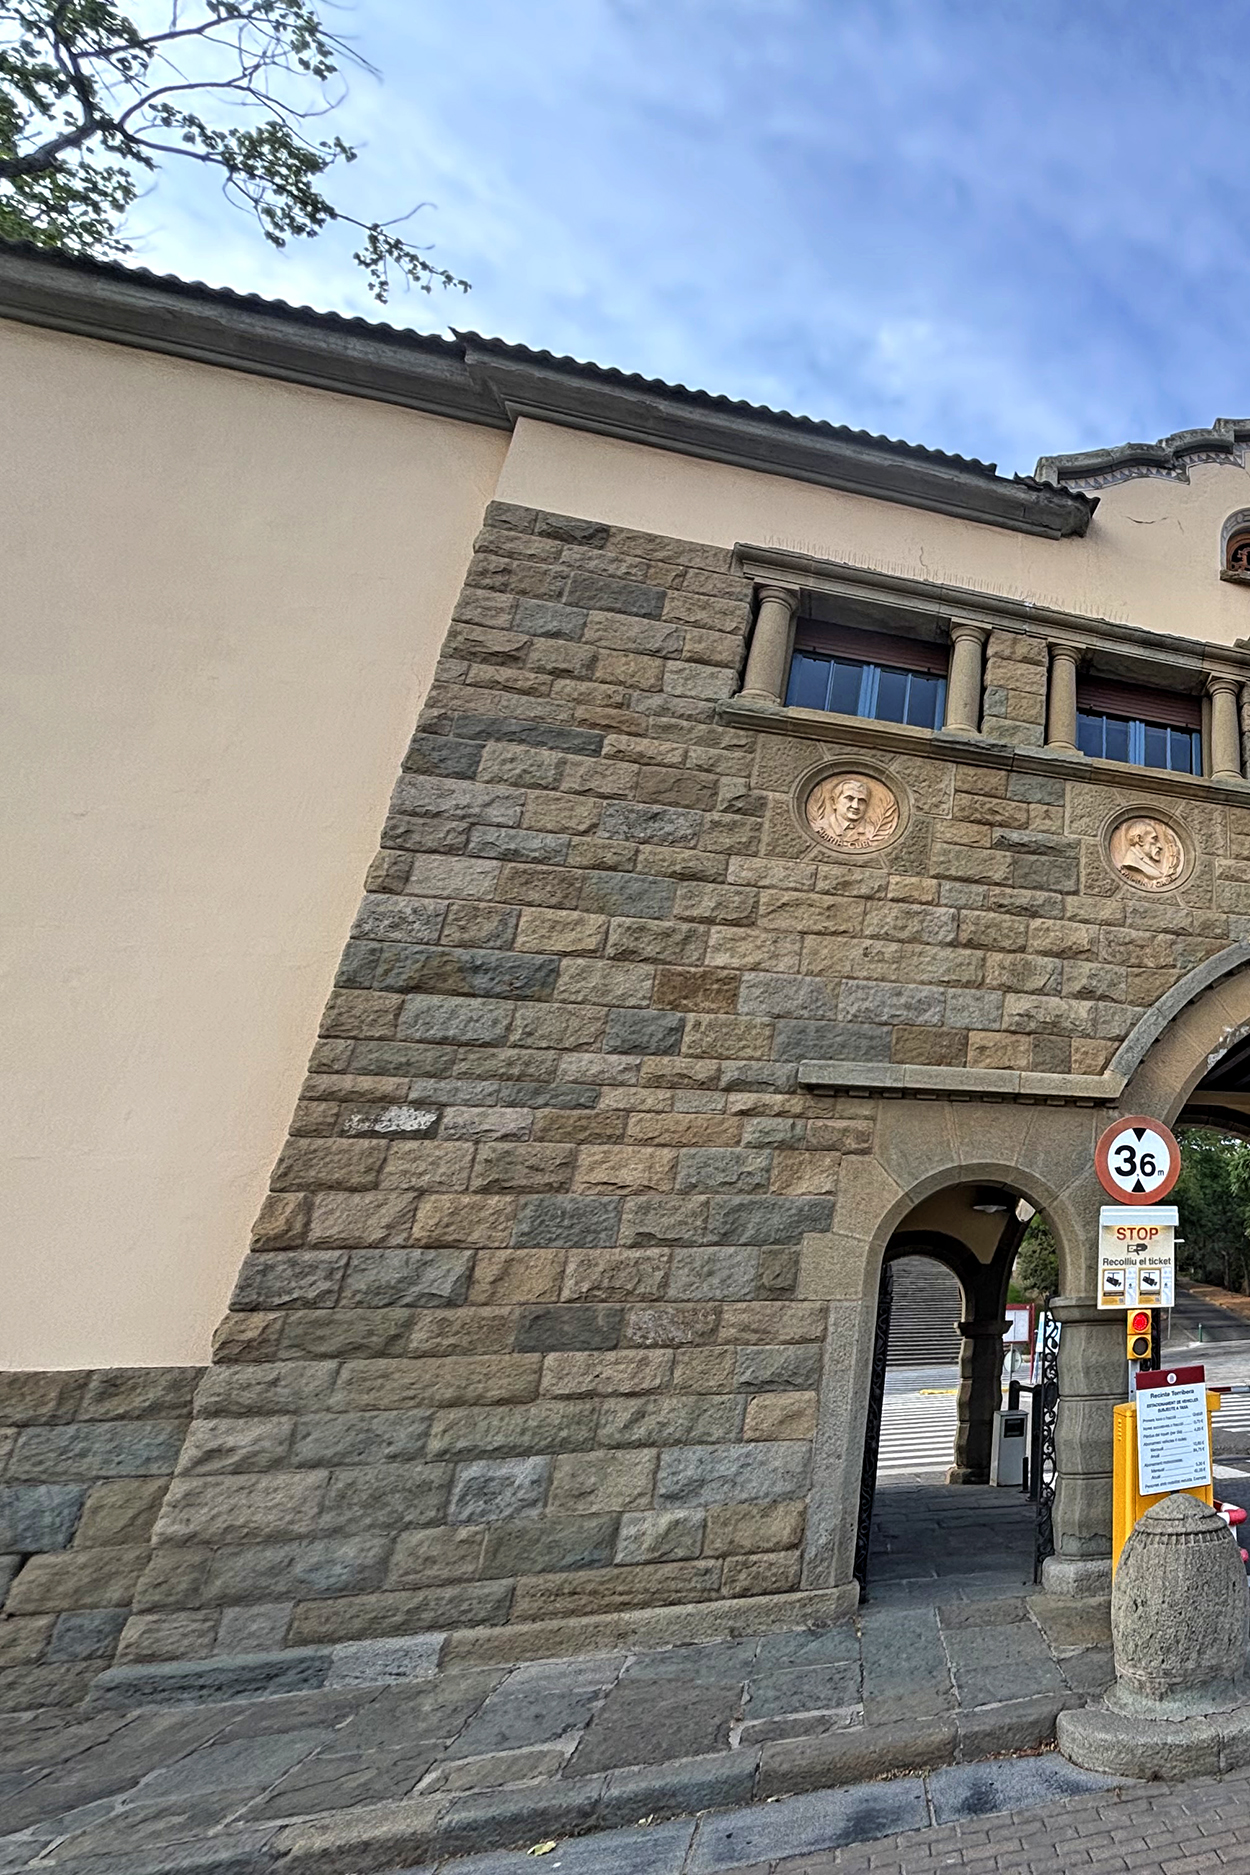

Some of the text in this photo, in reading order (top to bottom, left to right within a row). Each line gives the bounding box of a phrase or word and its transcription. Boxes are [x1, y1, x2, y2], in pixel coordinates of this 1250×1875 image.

[1116, 1227, 1159, 1241] STOP
[1103, 1256, 1171, 1266] Recolliu el ticket
